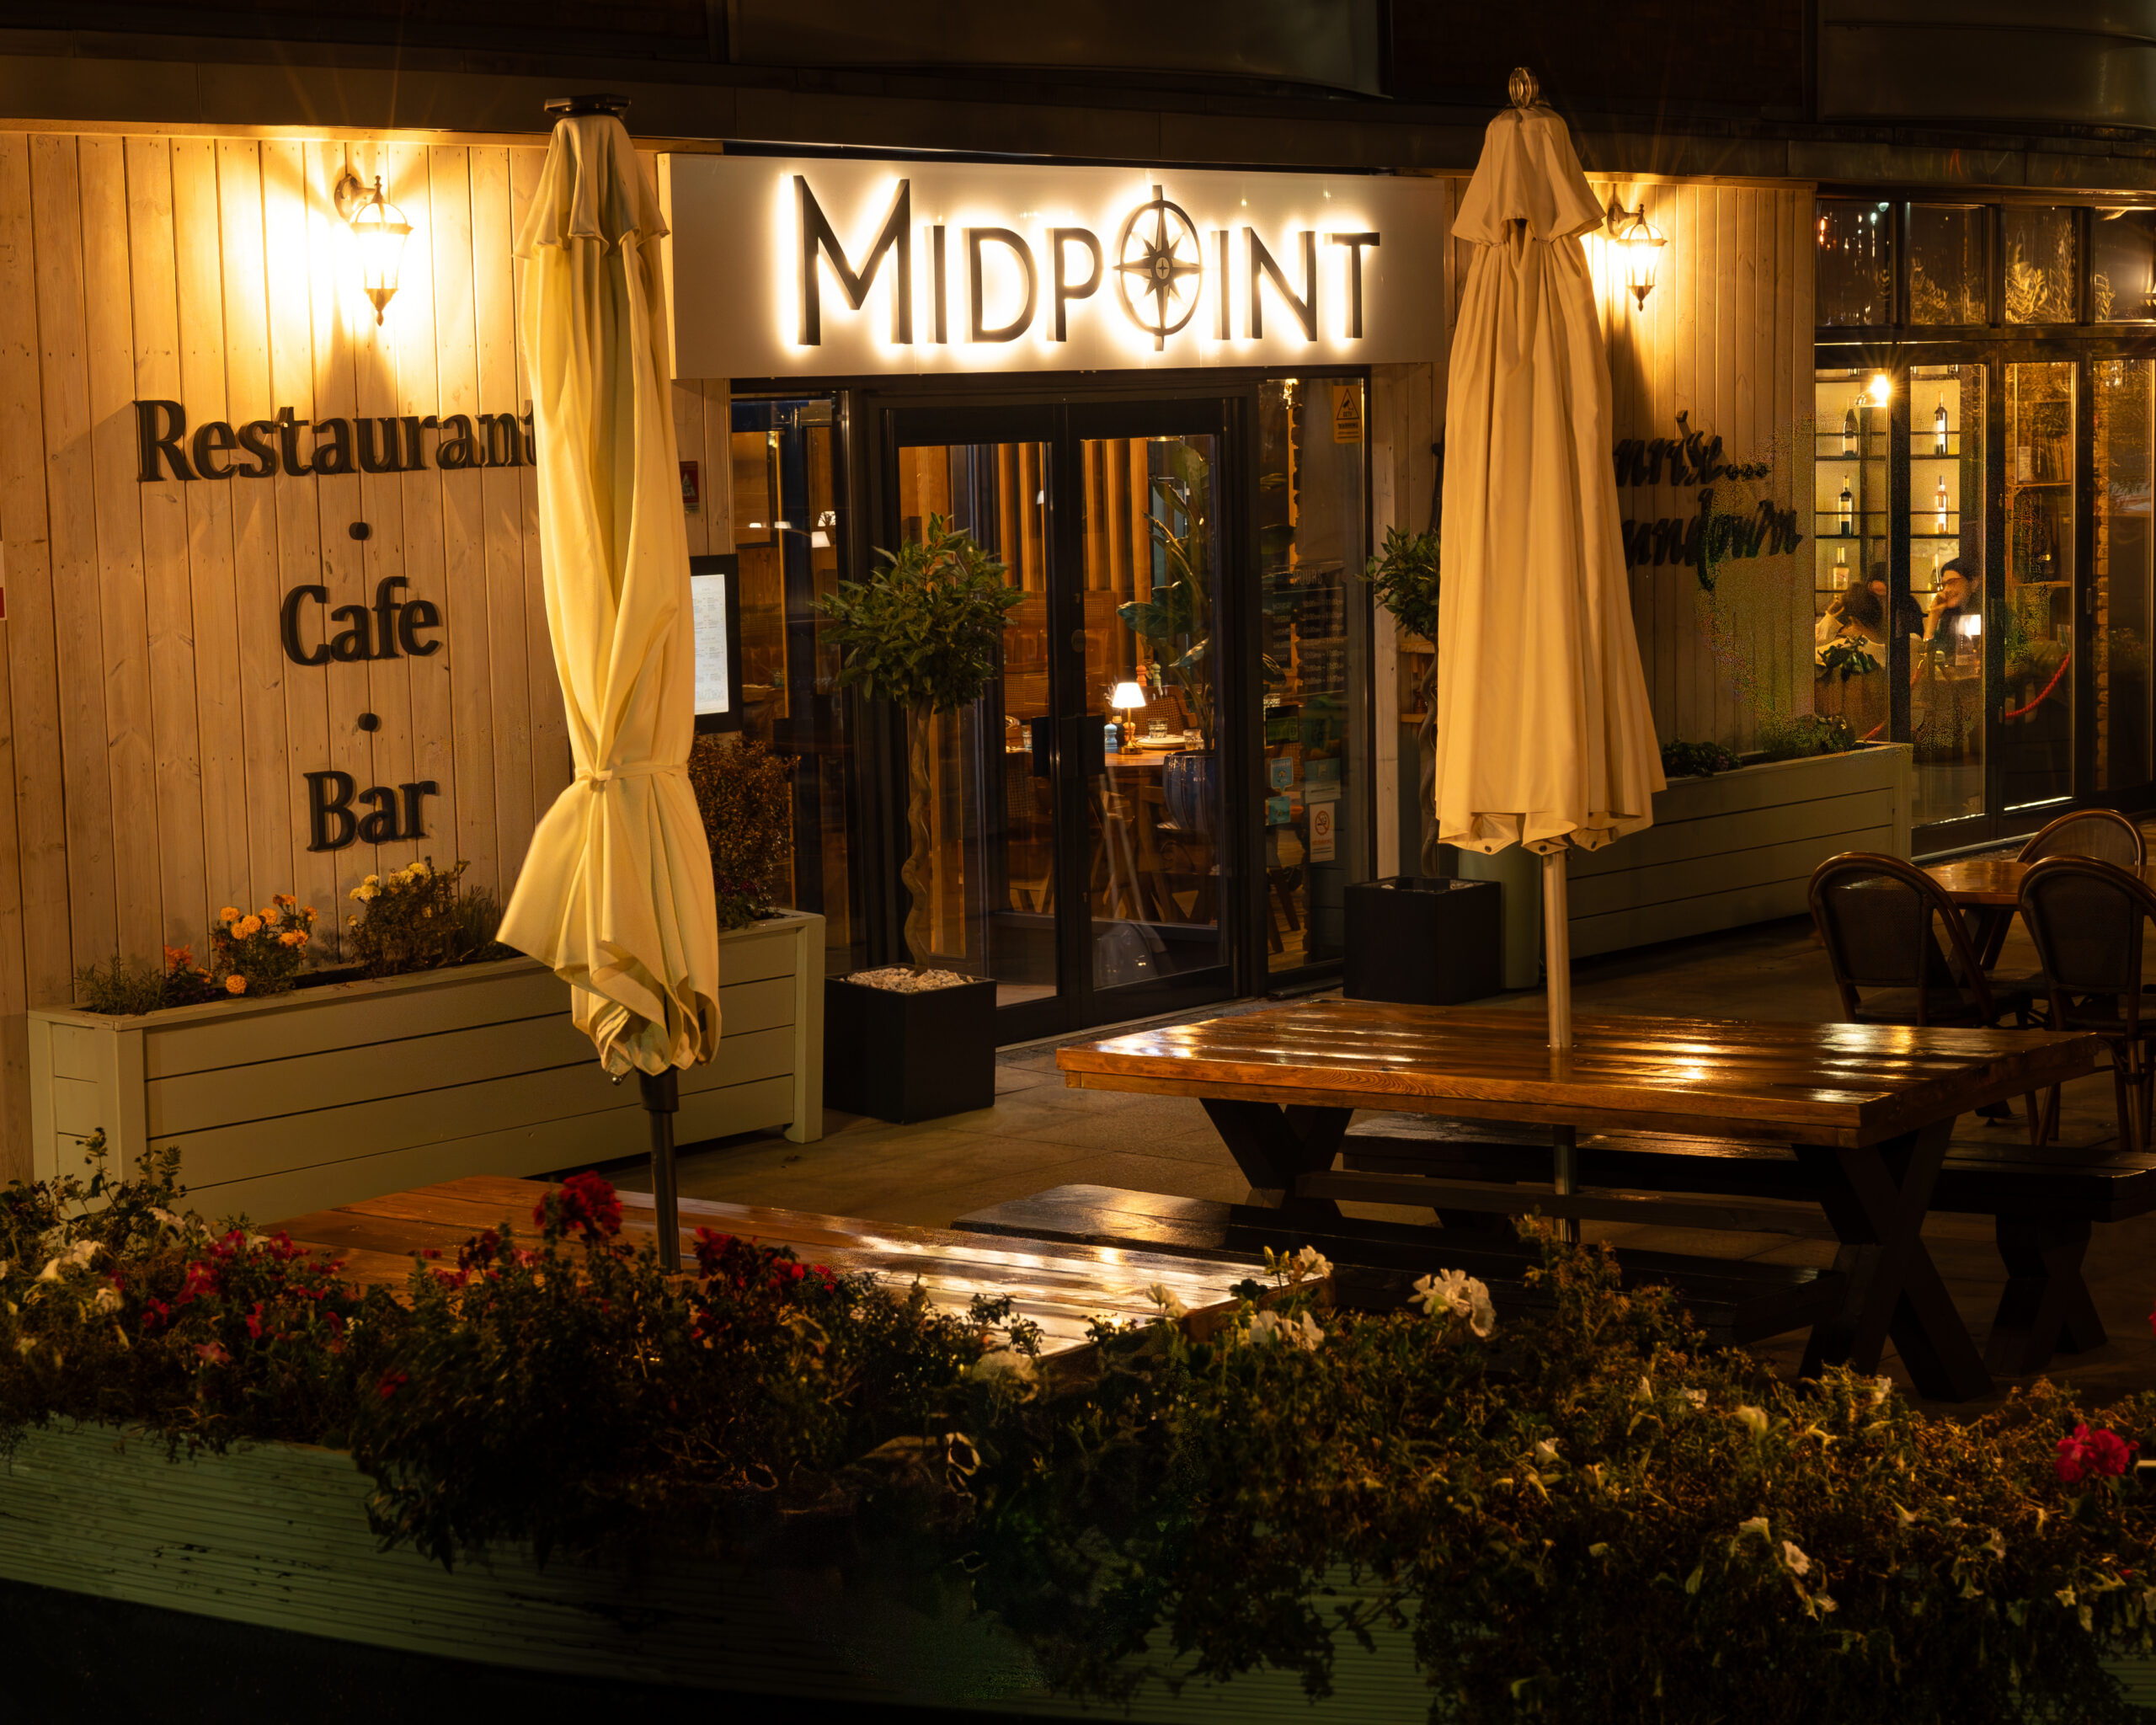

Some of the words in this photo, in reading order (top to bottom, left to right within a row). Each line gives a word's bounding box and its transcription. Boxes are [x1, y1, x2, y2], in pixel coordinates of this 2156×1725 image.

[792, 174, 1380, 351] MIDPOINT
[281, 576, 443, 667] Cafe
[303, 770, 440, 853] Bar
